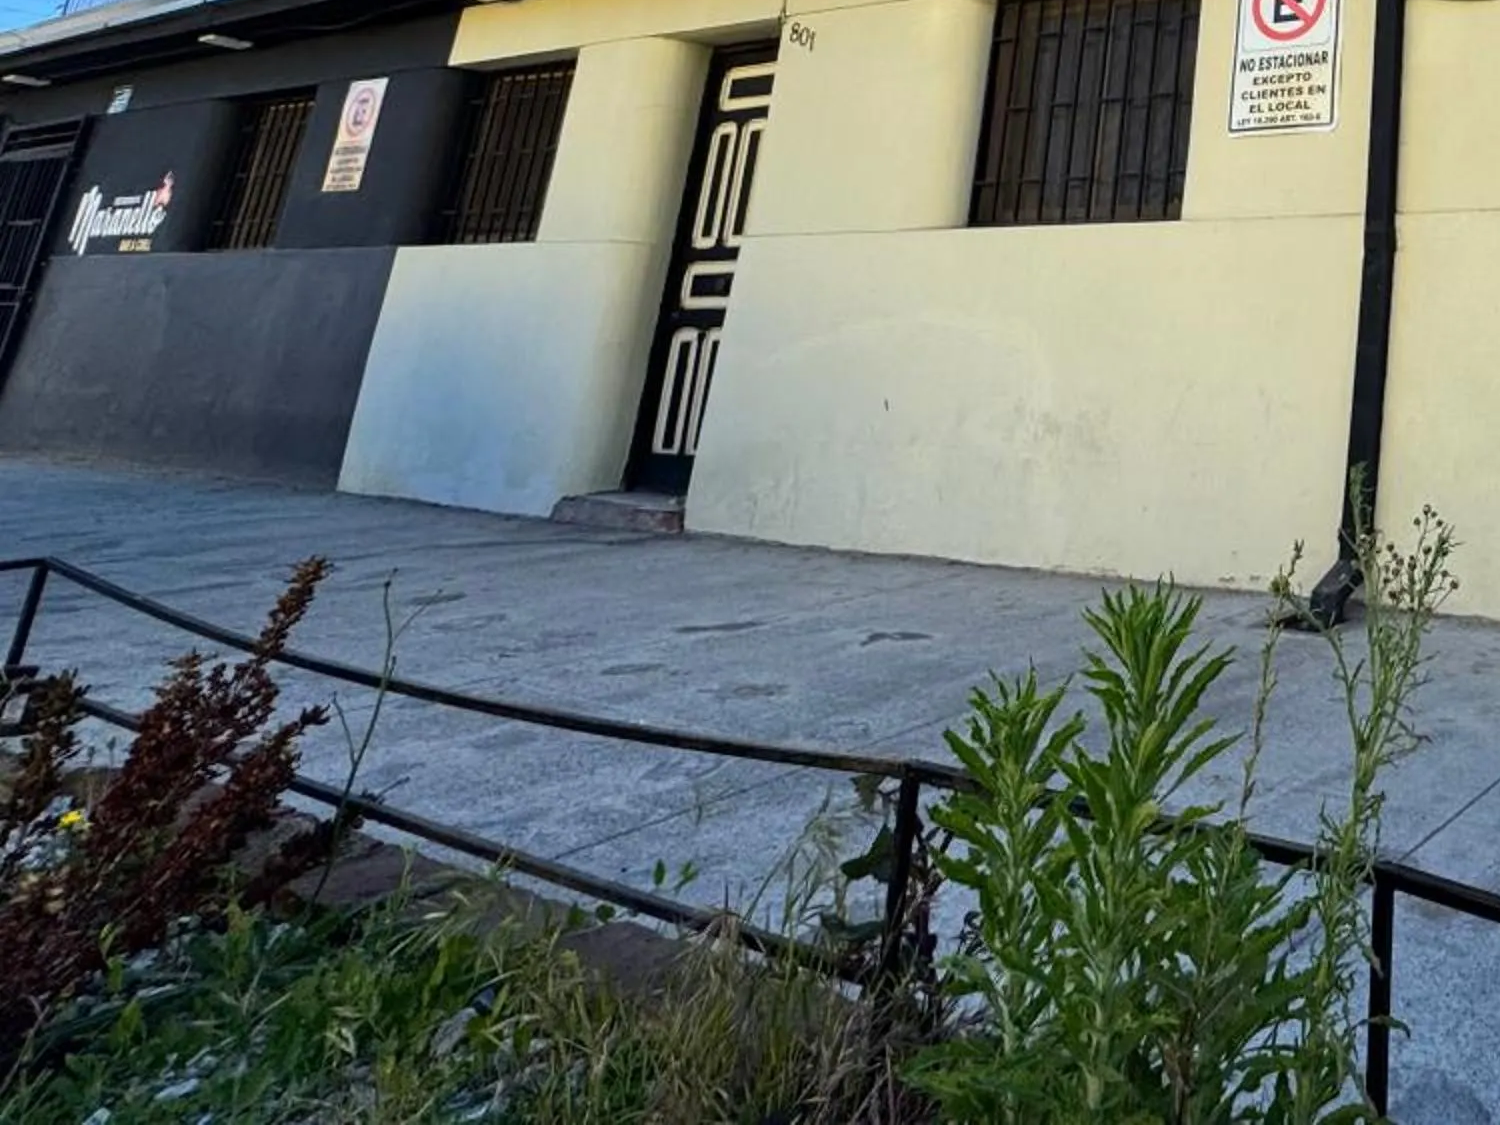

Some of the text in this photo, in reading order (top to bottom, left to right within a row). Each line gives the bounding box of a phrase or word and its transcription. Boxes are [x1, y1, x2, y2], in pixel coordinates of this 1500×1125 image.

[788, 21, 817, 52] 801
[1240, 50, 1329, 73] NO ESTACIONAR
[1252, 72, 1313, 86] EXCEPTO
[1240, 84, 1327, 101] CLIENTES EN
[1249, 100, 1311, 114] EL LOCAL
